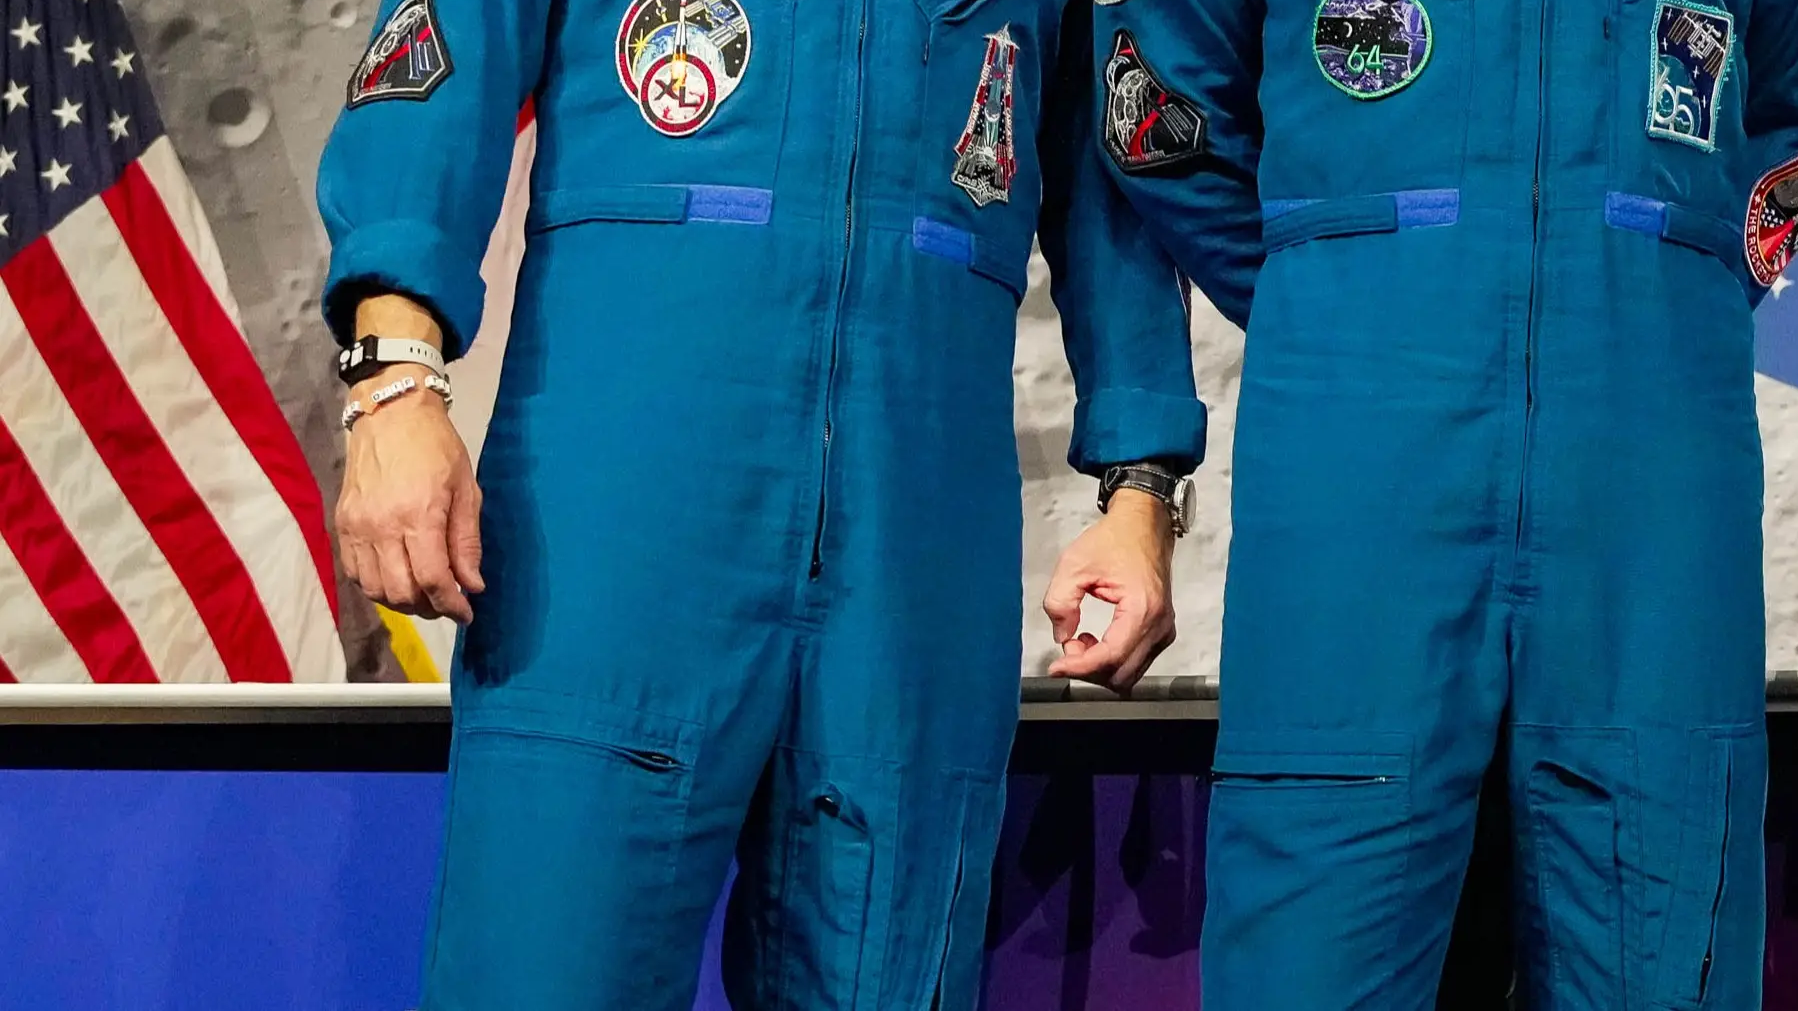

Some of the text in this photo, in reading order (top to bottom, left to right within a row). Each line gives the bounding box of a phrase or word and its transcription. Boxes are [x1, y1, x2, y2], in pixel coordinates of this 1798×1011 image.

[1347, 44, 1384, 75] 64
[653, 77, 700, 108] XL
[1654, 66, 1694, 136] 65
[1748, 208, 1757, 234] THE
